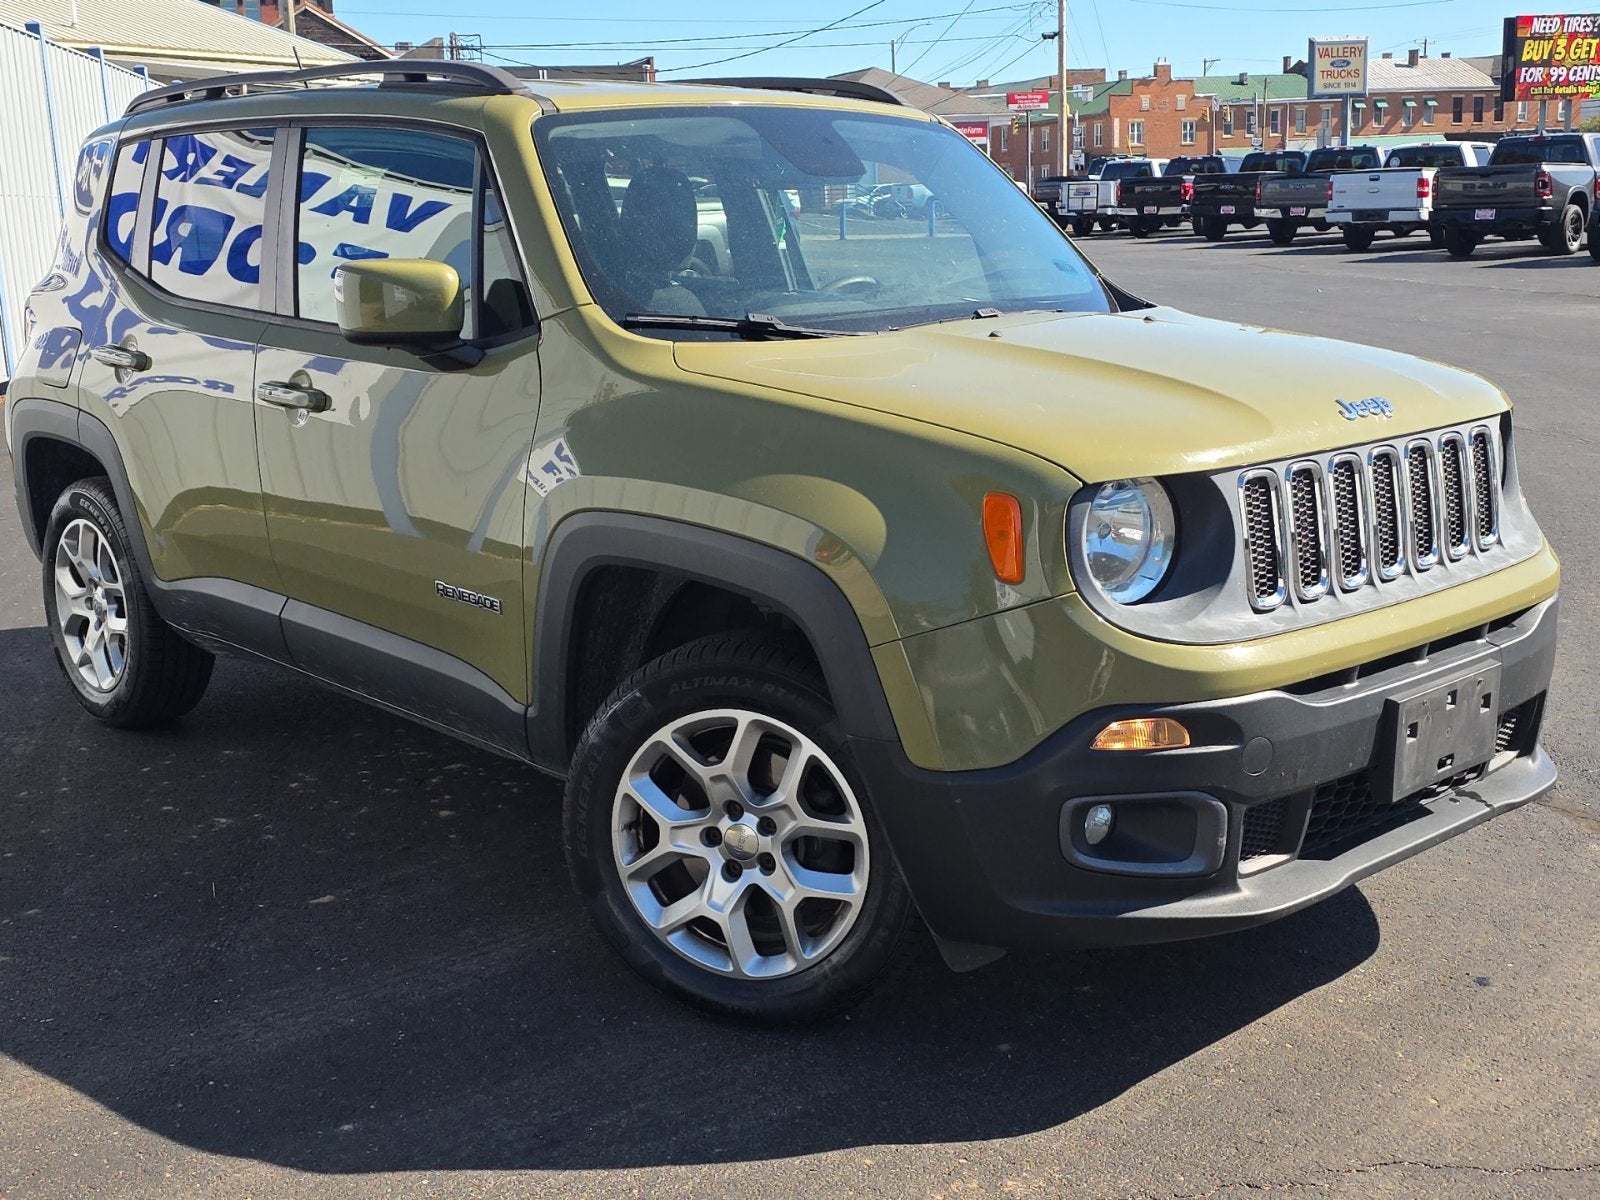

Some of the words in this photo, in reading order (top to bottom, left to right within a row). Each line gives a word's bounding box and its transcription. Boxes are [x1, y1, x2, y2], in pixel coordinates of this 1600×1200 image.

[1531, 17, 1560, 33] NEED
[1563, 16, 1600, 32] TIRES?
[1317, 46, 1363, 58] VALLERY
[1521, 39, 1554, 62] BUY
[1554, 38, 1567, 61] 3
[1569, 38, 1600, 60] GET
[1320, 68, 1360, 79] TRUCKS
[1520, 66, 1544, 83] FOR
[1549, 66, 1567, 82] 99
[1569, 65, 1600, 82] CENTS
[1530, 86, 1543, 95] Call
[1543, 86, 1554, 94] for
[1554, 85, 1577, 94] details
[1462, 182, 1508, 191] RAM
[1334, 397, 1393, 421] Jeep
[435, 580, 502, 614] RENEGADE
[669, 675, 755, 696] ALTIMAX
